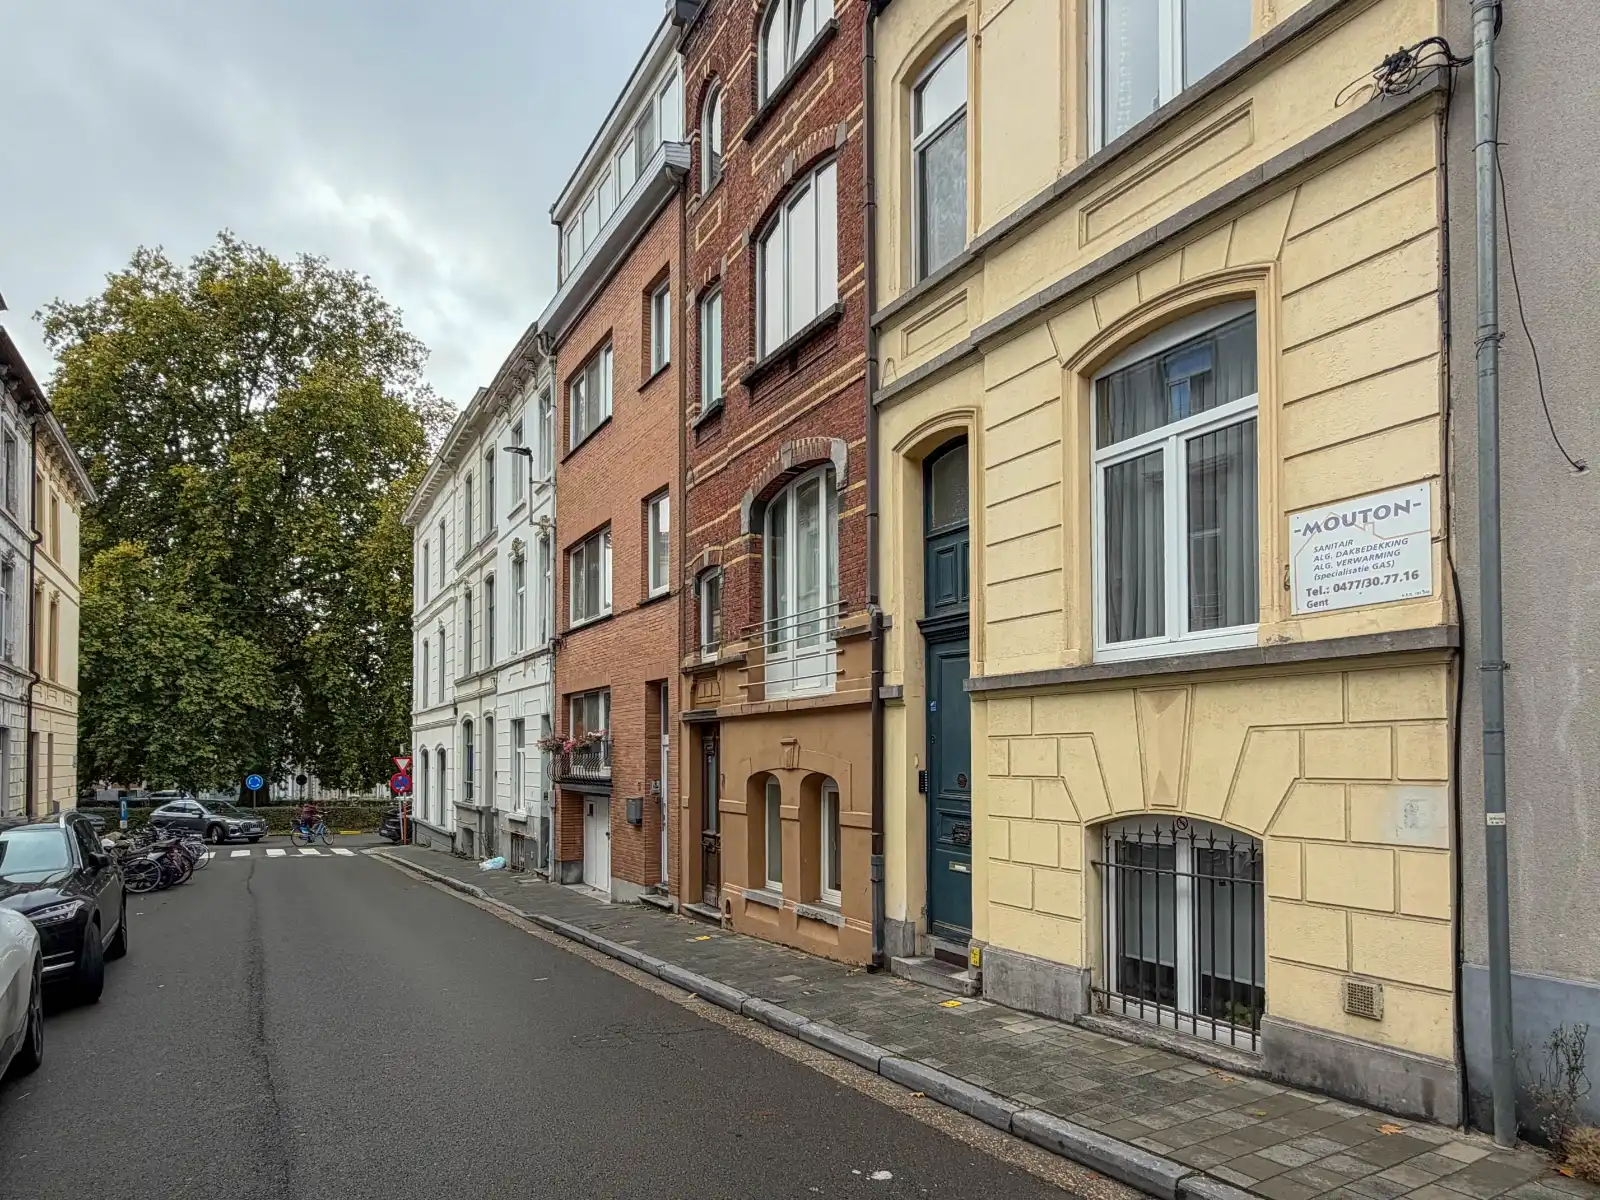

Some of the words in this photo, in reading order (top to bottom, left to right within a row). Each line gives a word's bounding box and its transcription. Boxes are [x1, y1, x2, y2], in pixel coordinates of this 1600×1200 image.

[1313, 539, 1354, 553] SANITAIR
[1313, 553, 1333, 562] ALG.
[1336, 538, 1409, 558] DAKBEDEKKING
[1313, 563, 1333, 572] ALG.
[1336, 549, 1401, 567] VERWARMING
[1314, 564, 1369, 581] (specialisatie
[1372, 560, 1395, 570] GAS)
[1306, 585, 1330, 597] Tel.:
[1333, 570, 1420, 593] 0477/30.77.16
[1306, 599, 1329, 609] Gent
